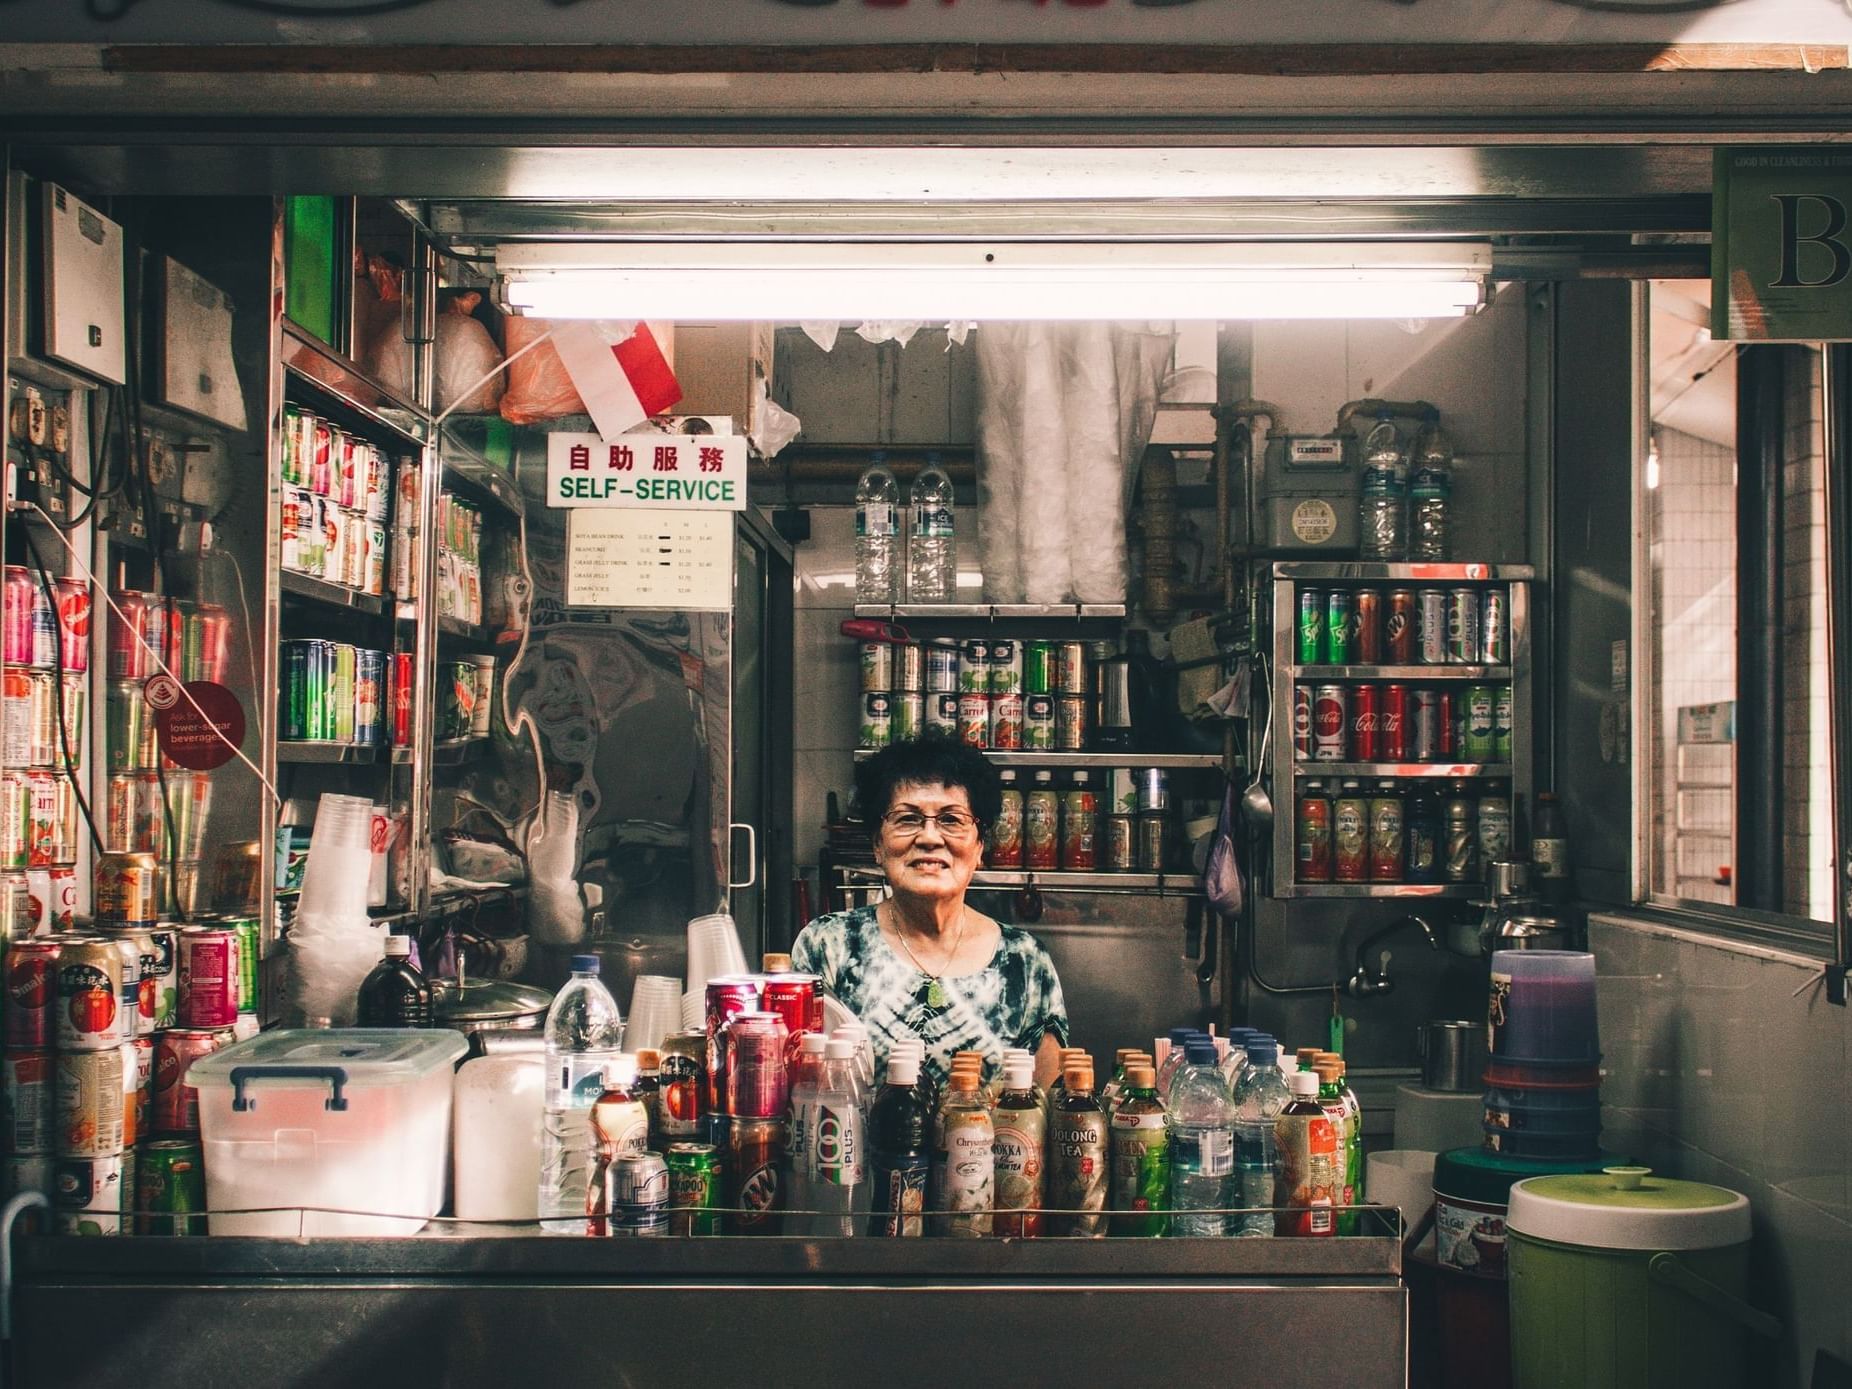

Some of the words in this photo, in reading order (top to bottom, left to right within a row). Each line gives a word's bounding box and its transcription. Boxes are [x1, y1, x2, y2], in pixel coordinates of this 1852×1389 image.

[1768, 193, 1852, 289] B
[570, 444, 724, 472] 自助服務
[560, 477, 736, 501] SELF-SERVICE
[844, 1129, 853, 1164] PLUS
[1051, 1128, 1097, 1143] OOLONG
[1061, 1143, 1083, 1157] TEA
